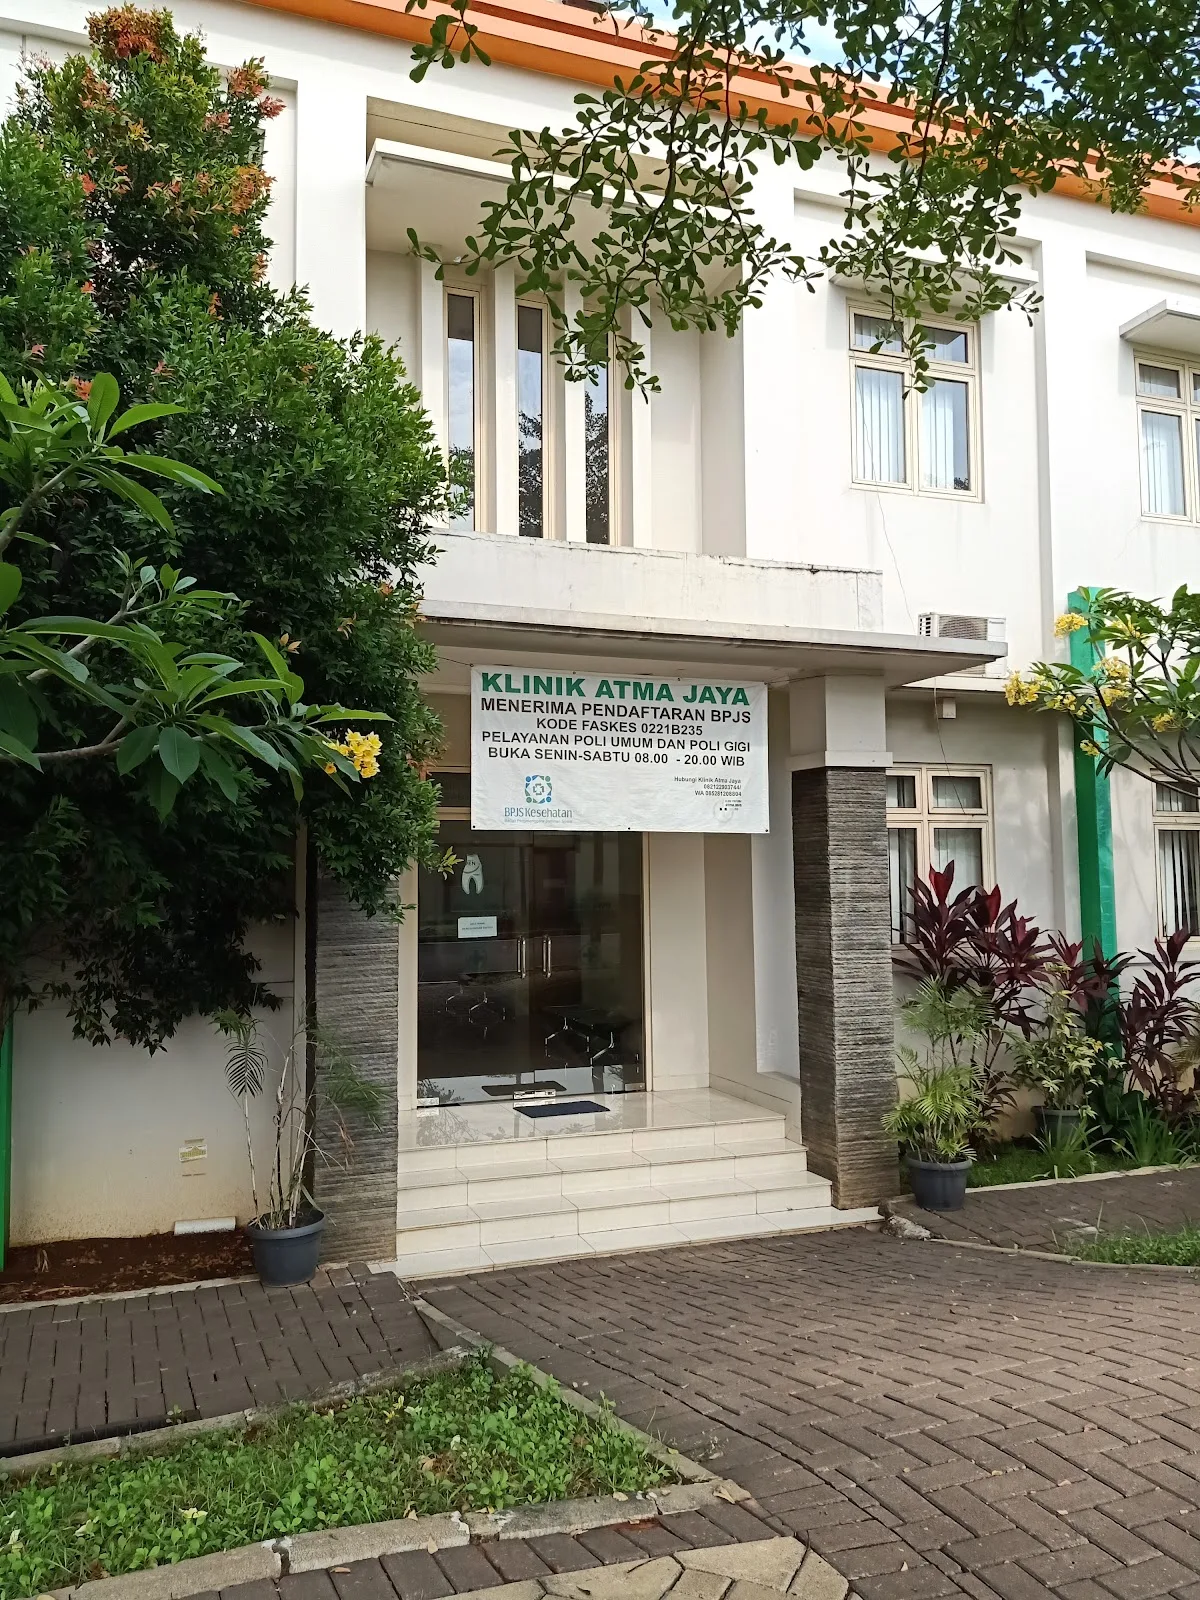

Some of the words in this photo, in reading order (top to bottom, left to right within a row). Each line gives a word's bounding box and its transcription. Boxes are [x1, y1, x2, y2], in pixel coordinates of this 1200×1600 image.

[481, 672, 586, 697] KLINIK
[595, 680, 674, 701] ATMA
[683, 685, 749, 705] JAYA
[481, 697, 577, 715] MENERIMA
[582, 703, 705, 721] PENDAFTARAN
[710, 709, 751, 724] BPJS
[536, 717, 578, 730] KODE
[582, 720, 637, 733] FASKES
[641, 723, 703, 736] 0221B235
[482, 731, 569, 745] PELAYANAN
[574, 735, 606, 747] POLI
[611, 736, 653, 749] UMUM
[657, 738, 686, 750] DAN
[689, 739, 720, 751] POLI
[724, 741, 751, 752] GIGI
[488, 746, 531, 759] BUKA
[534, 748, 630, 763] SENIN-SABTU
[634, 752, 669, 764] 08.00
[684, 754, 717, 766] 20.00
[720, 755, 746, 767] WIB
[504, 807, 524, 817] BPJS
[525, 807, 573, 818] Kesehatan
